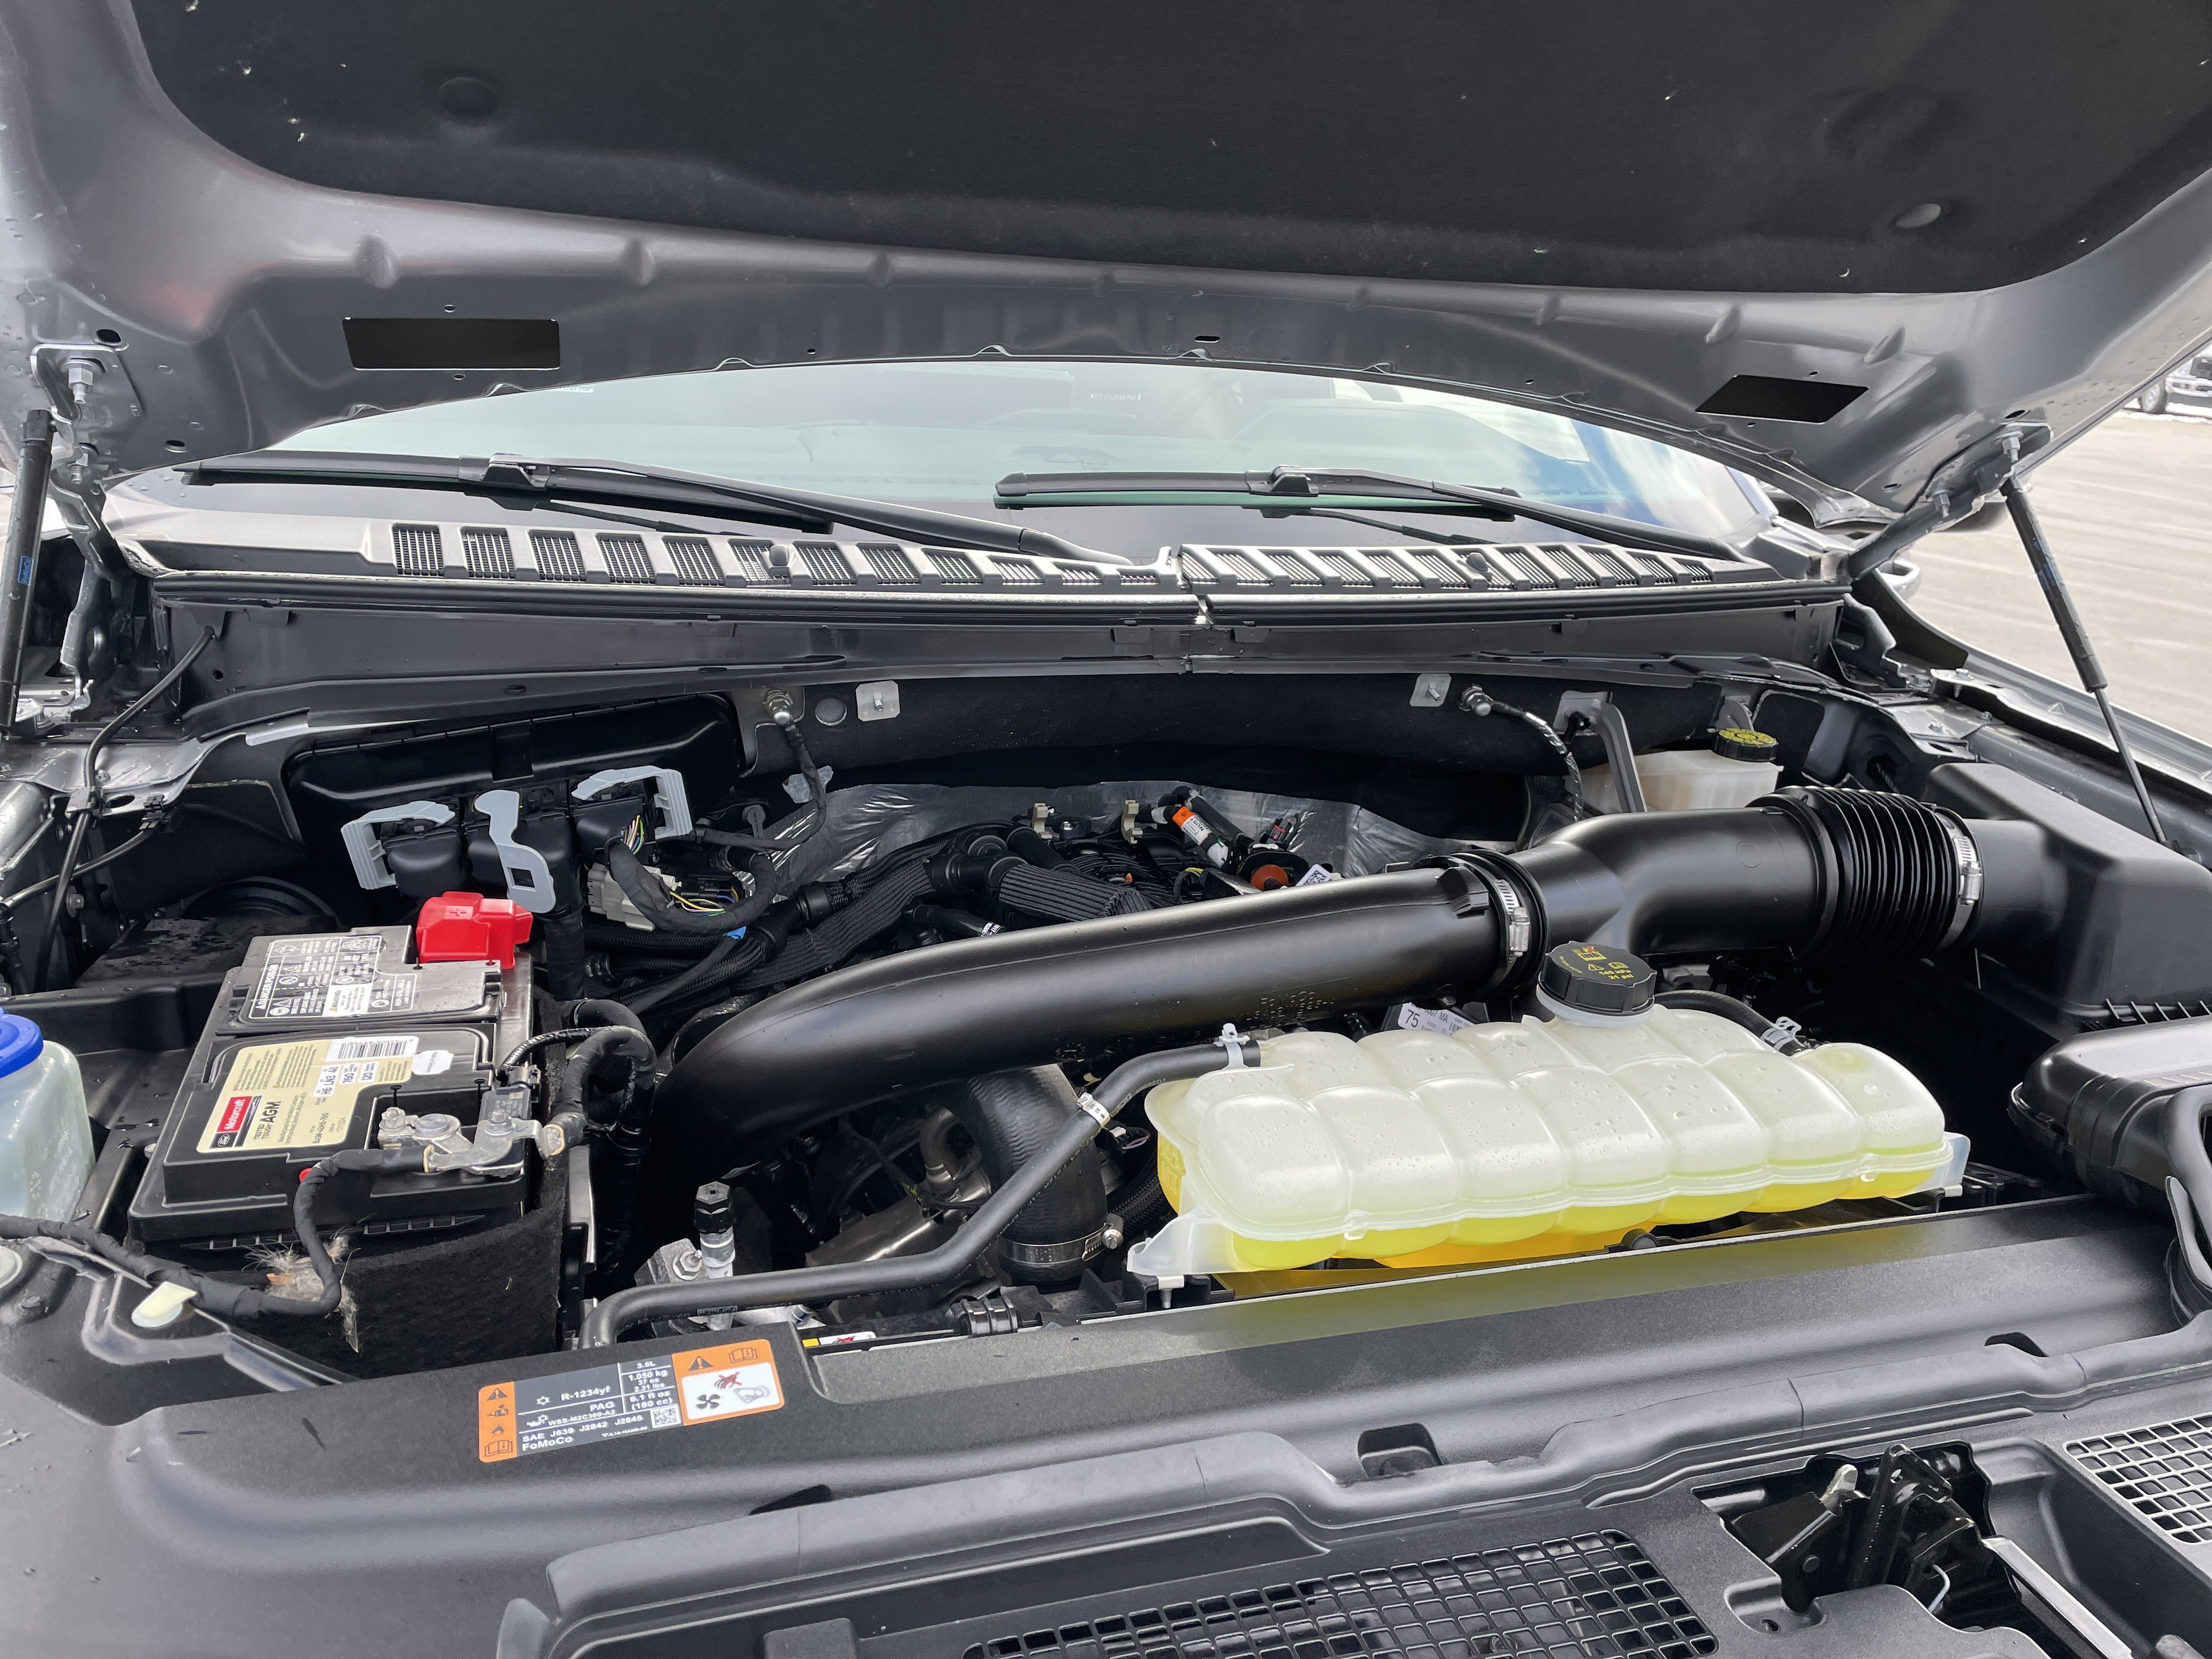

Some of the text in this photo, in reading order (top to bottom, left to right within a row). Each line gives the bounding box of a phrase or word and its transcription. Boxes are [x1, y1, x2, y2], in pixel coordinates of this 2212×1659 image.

[1405, 1009, 1420, 1028] 75
[324, 1075, 336, 1085] LN3
[343, 1073, 354, 1083] 760
[362, 1072, 373, 1080] 120
[224, 1099, 246, 1129] Motorcraft
[260, 1101, 281, 1123] AGM
[253, 1125, 265, 1139] TESTED
[628, 1371, 653, 1381] 1.050
[561, 1385, 612, 1401] R-1234yf
[634, 1384, 651, 1392] 2.31
[629, 1394, 645, 1402] 6.1
[631, 1396, 674, 1411] (180 cc)
[589, 1401, 616, 1412] PAG
[548, 1409, 616, 1426] WSS-M2C300-A2
[522, 1414, 644, 1442] SAE J639 J2842 J2845
[522, 1436, 574, 1451] FoMoCo
